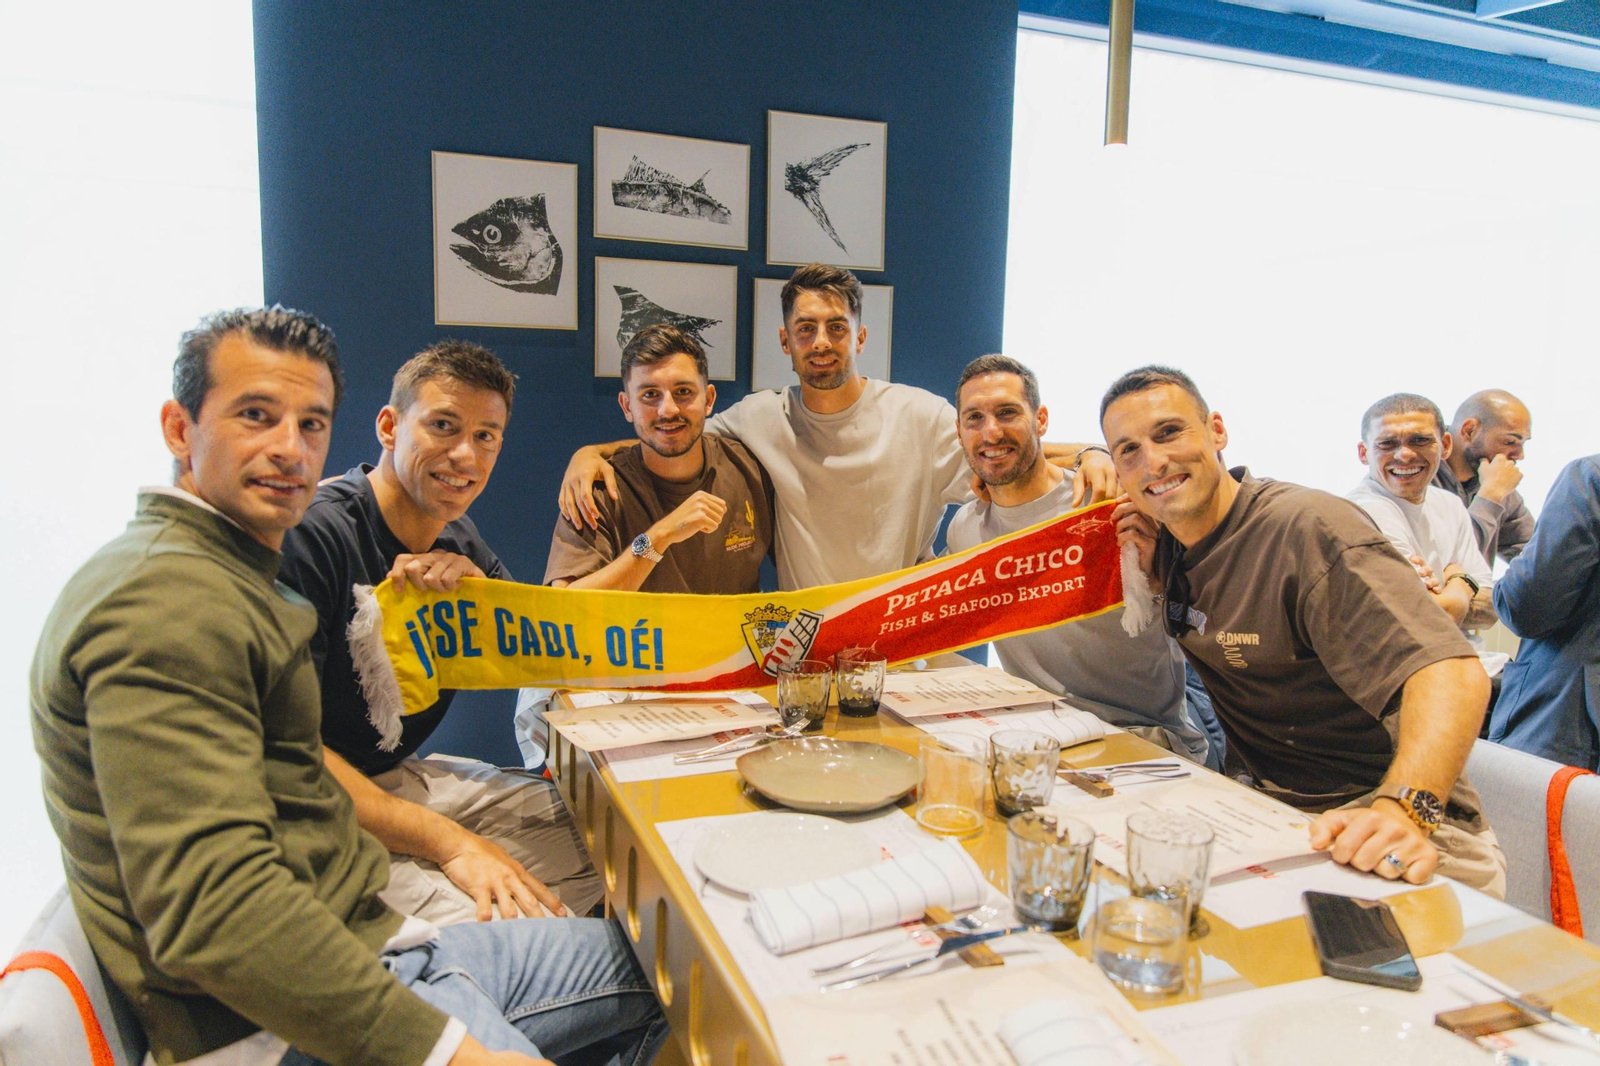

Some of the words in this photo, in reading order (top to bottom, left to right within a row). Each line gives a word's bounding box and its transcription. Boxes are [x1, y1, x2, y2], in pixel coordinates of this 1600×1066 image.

[878, 615, 917, 636] FISH
[921, 610, 935, 624] &
[939, 592, 1014, 619] SEAFOOD
[1018, 575, 1086, 602] EXPORT
[884, 568, 986, 617] PETACA
[994, 544, 1084, 580] CHICO
[494, 607, 592, 666] CADI,
[605, 618, 664, 671] OÉ!
[1226, 632, 1260, 646] DNWR
